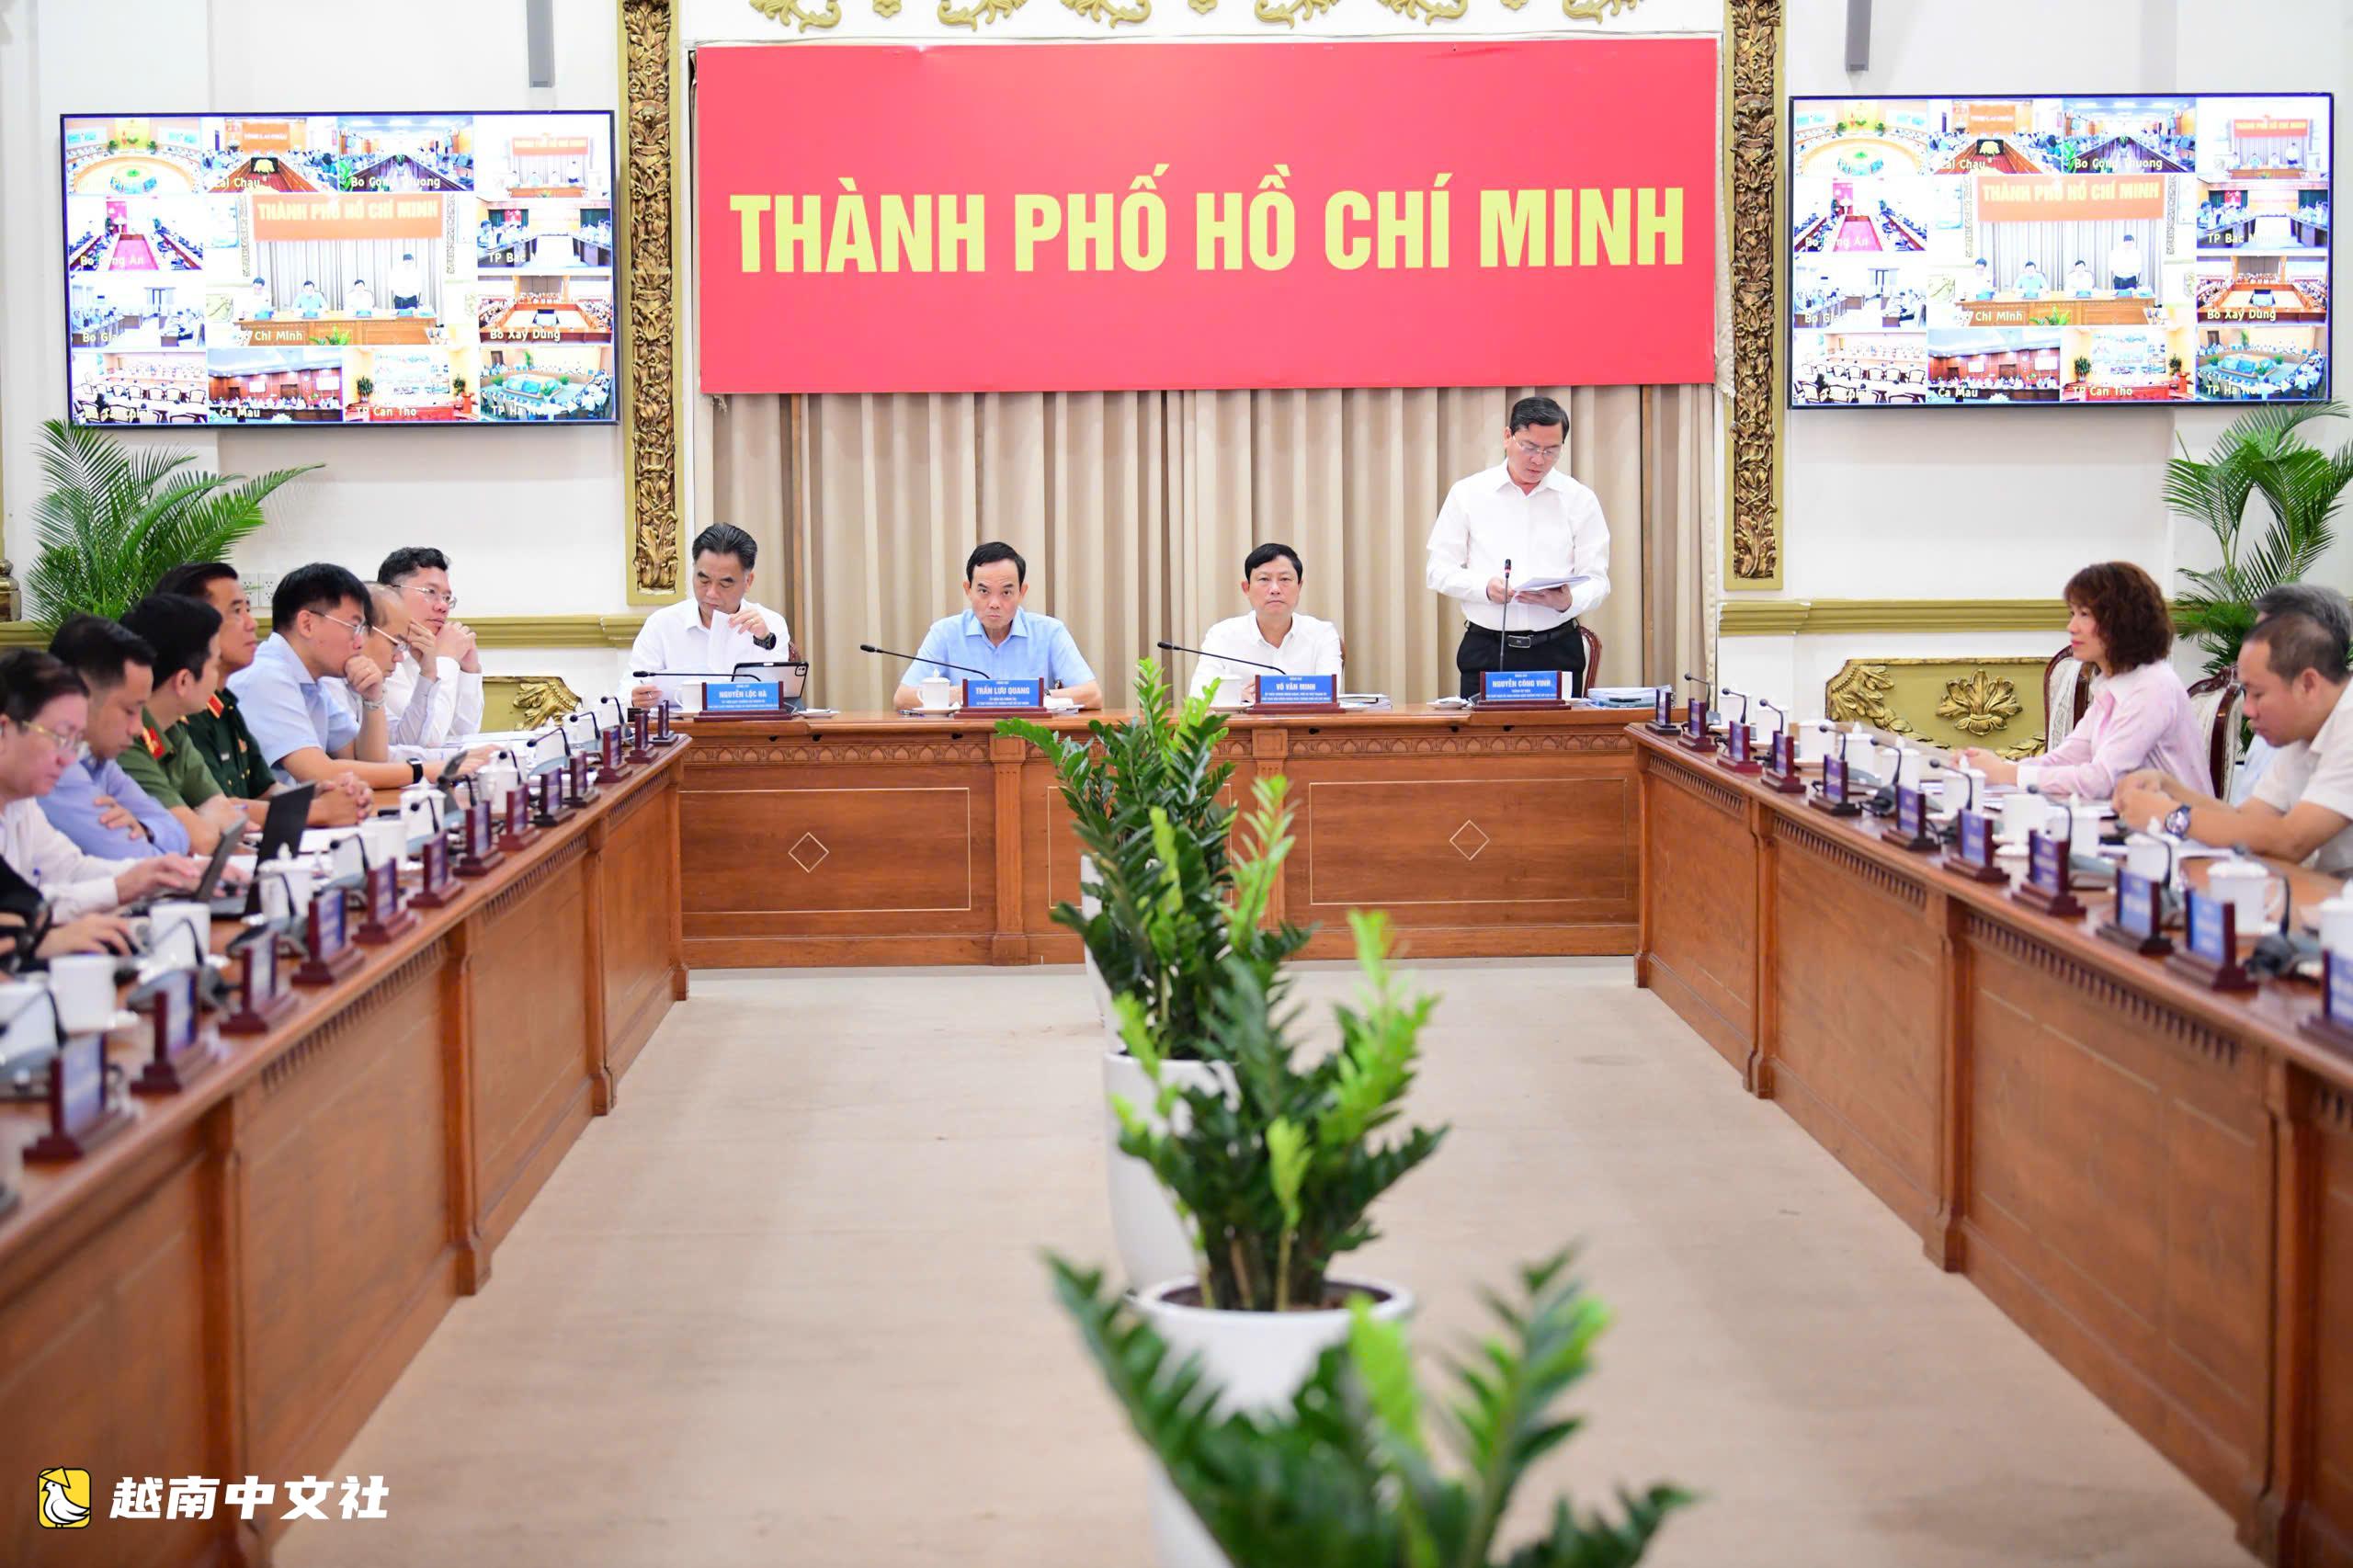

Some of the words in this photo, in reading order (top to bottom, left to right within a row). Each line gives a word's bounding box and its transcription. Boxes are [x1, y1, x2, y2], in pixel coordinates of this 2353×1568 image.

[1960, 159, 1985, 170] Chau
[2075, 158, 2087, 168] Bo
[234, 177, 260, 187] Chau
[351, 176, 364, 187] Bo
[729, 177, 985, 273] THÀNH
[1015, 164, 1170, 272] PHỐ
[1196, 164, 1295, 271] HỒ
[1324, 173, 1453, 270] CHÍ
[1480, 187, 1684, 267] MINH
[2208, 233, 2220, 244] TP
[2225, 233, 2245, 244] Bac
[489, 253, 501, 263] TP
[1975, 311, 1991, 322] Chi
[1996, 311, 2022, 322] Minh
[2207, 310, 2221, 320] Bo
[2224, 310, 2244, 321] Xay
[2248, 310, 2277, 322] Dung
[255, 330, 271, 341] Chi
[276, 330, 302, 341] Minh
[490, 330, 503, 340] Bo
[507, 330, 528, 342] Xay
[533, 330, 561, 342] Dung
[1938, 388, 1950, 398] Ca
[1955, 388, 1978, 398] Mau
[2090, 386, 2109, 396] Can
[2115, 386, 2132, 396] Tho
[2206, 385, 2219, 395] TP
[2224, 385, 2237, 395] Ha
[220, 408, 233, 418] Ca
[237, 408, 260, 418] Mau
[373, 406, 392, 416] Can
[399, 406, 416, 416] Tho
[492, 405, 505, 415] TP
